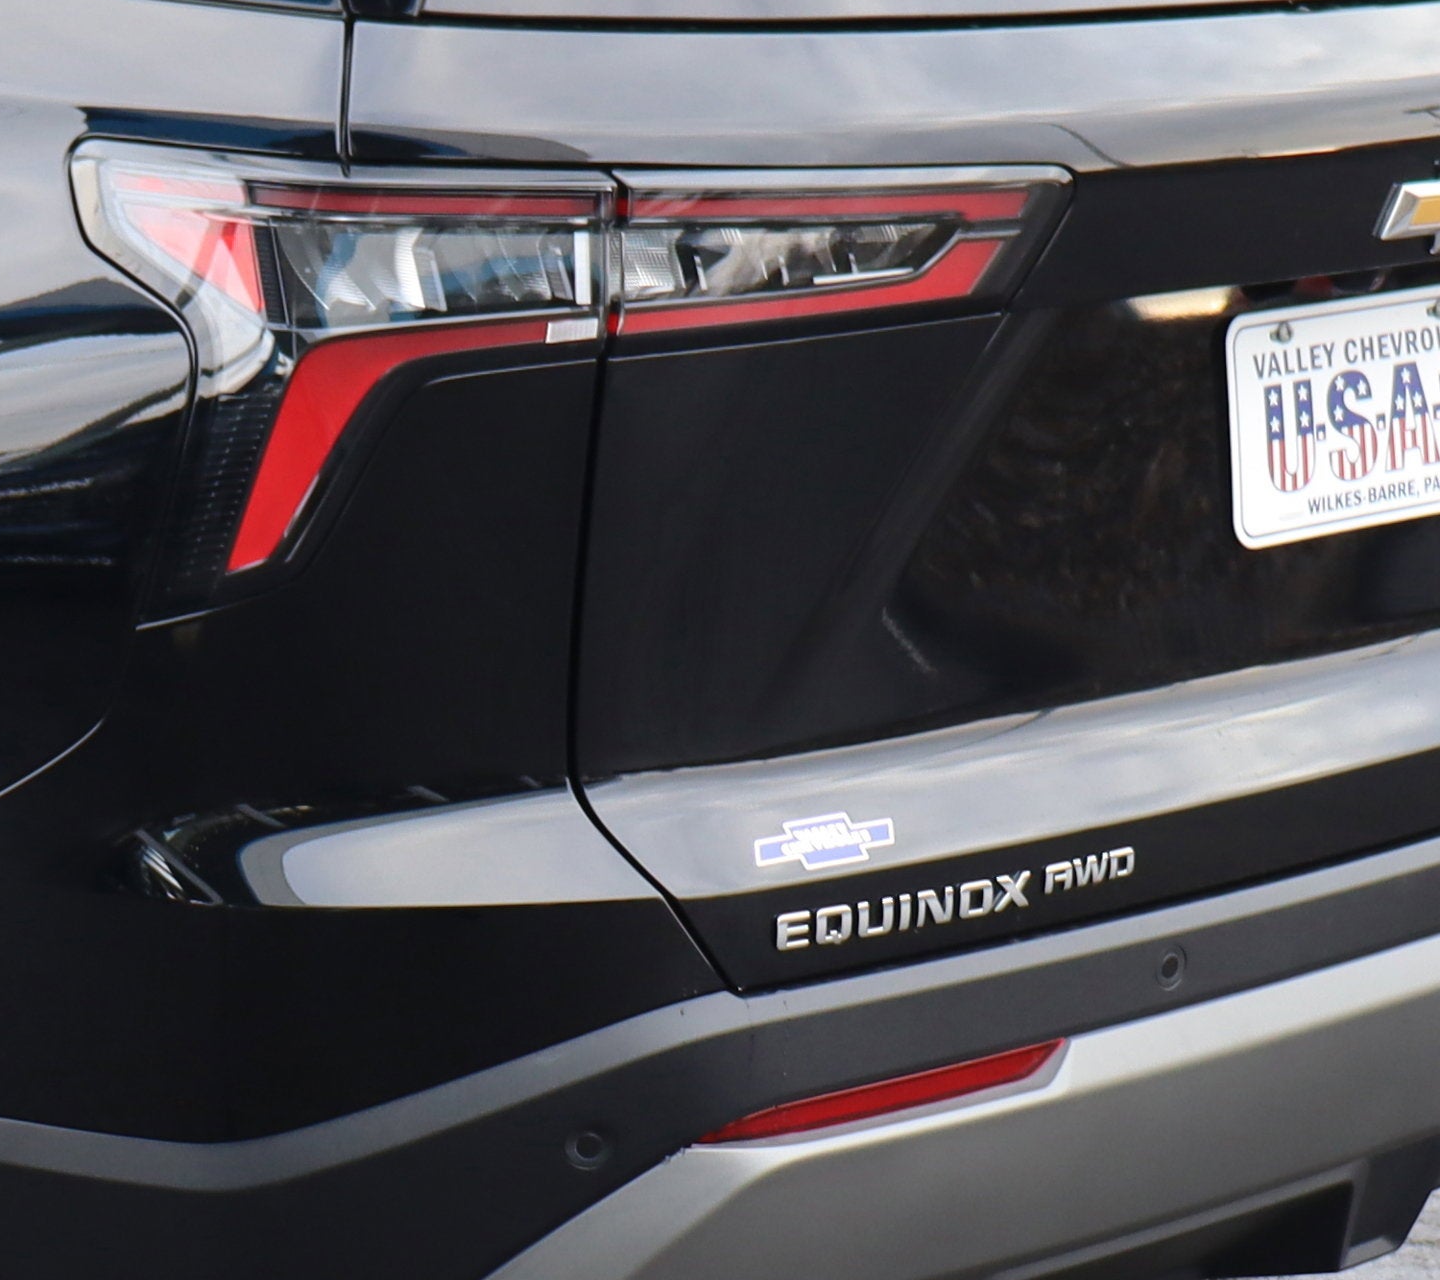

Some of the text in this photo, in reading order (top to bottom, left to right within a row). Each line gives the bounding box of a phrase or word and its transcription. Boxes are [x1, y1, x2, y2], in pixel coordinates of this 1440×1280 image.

[1253, 341, 1337, 380] VALLEY
[1307, 481, 1421, 515] WILKES-BARRE,
[775, 846, 1135, 951] EQUINOX AWD
